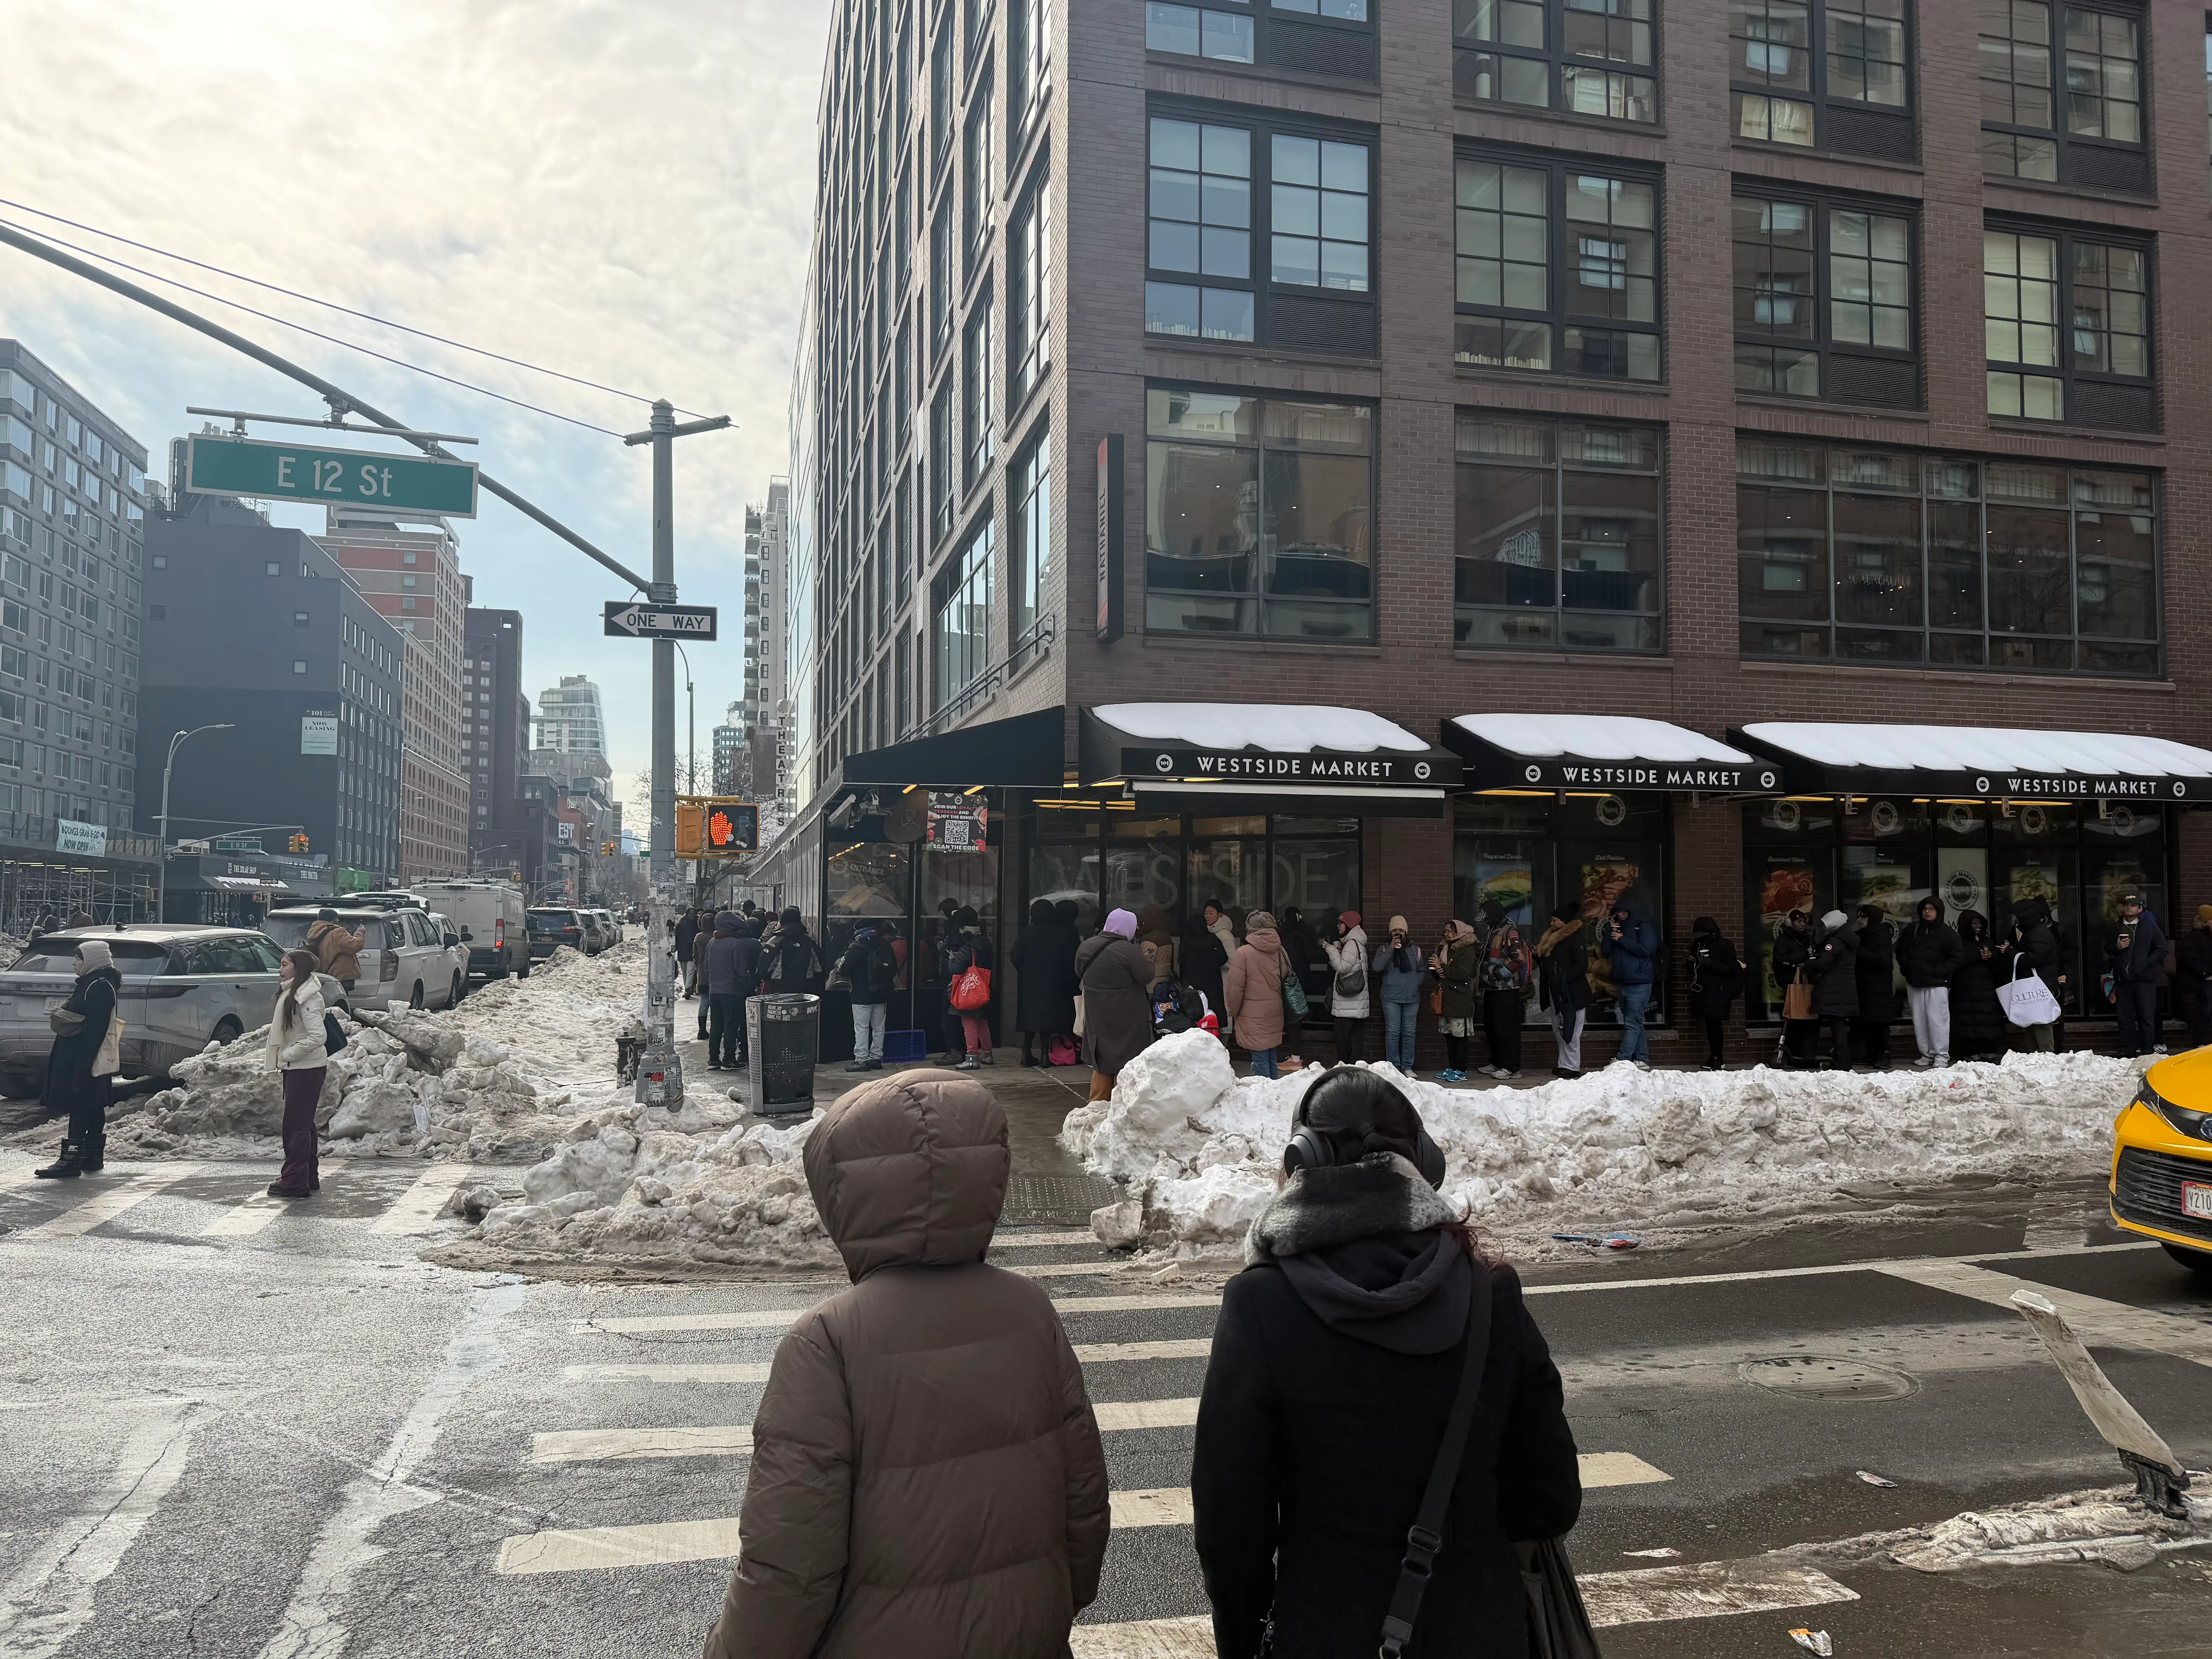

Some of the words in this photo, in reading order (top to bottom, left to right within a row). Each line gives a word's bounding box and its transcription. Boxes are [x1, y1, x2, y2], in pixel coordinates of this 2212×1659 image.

[277, 456, 295, 488] E
[314, 460, 343, 492] 12
[359, 465, 392, 497] St
[627, 613, 656, 627] ONE
[673, 616, 704, 629] WAY
[1197, 757, 1301, 774] WESTSIDE
[1311, 760, 1392, 776] MARKET
[1563, 767, 1657, 783] WESTSIDE
[1667, 770, 1740, 785] MARKET
[2008, 778, 2087, 793] WESTSIDE
[2095, 781, 2156, 794] MARKET
[64, 839, 76, 850] NOW
[77, 841, 89, 852] OPEN
[308, 871, 318, 879] SMITH
[850, 864, 885, 876] ENTRANCE
[806, 1005, 818, 1014] NYC
[2189, 1191, 2212, 1210] Y210
